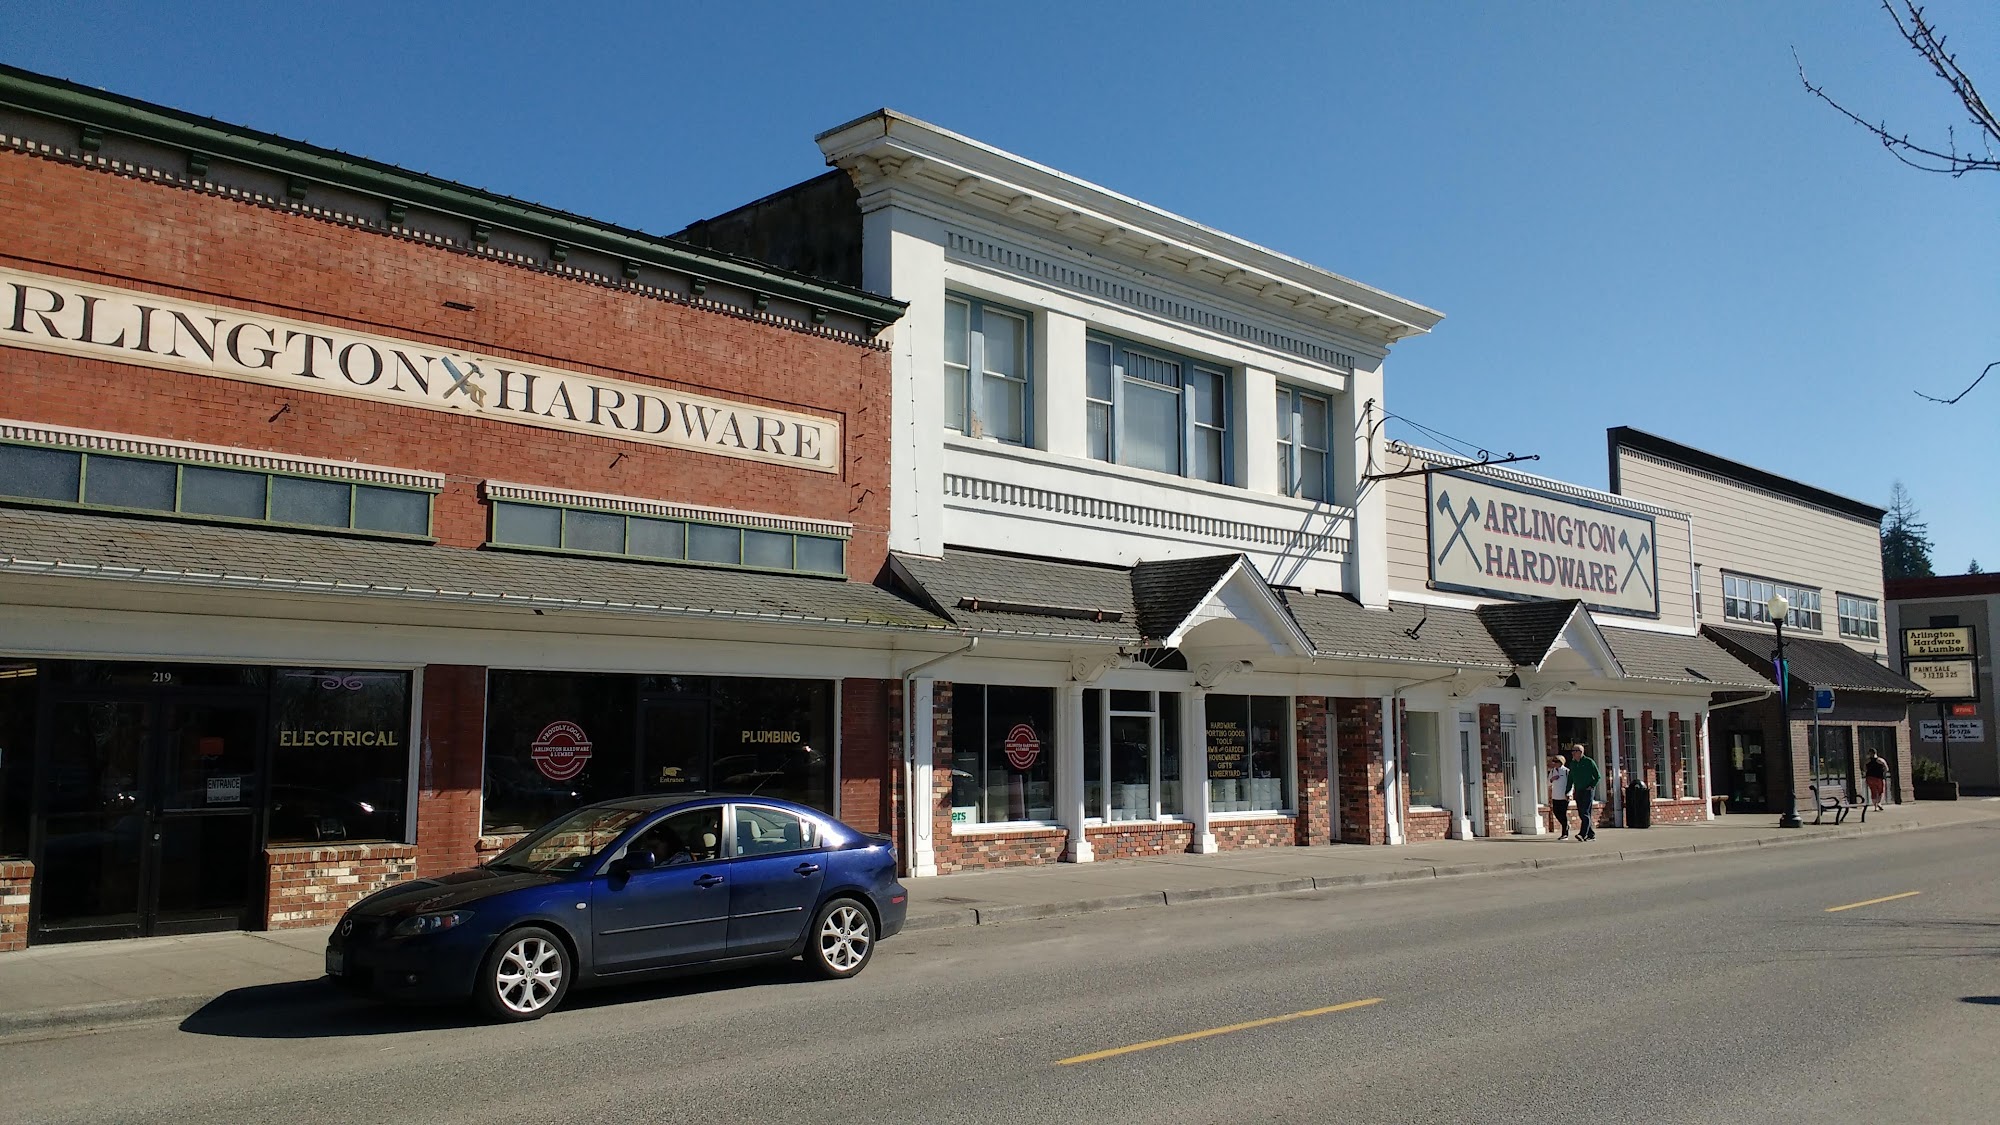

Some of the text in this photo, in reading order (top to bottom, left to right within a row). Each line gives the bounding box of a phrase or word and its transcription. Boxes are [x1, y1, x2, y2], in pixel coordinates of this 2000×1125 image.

[3, 282, 822, 461] RLINGTON HARDWARE
[1484, 499, 1616, 555] ARLINGTON
[1485, 543, 1618, 594] HARDWARE
[1913, 637, 1961, 646] Hardware
[1927, 645, 1965, 653] Lumber
[152, 671, 172, 682] 219
[280, 730, 399, 747] ELECTRICAL
[542, 724, 583, 741] PROUDLY LOCAL
[741, 730, 801, 743] PLUMBING
[208, 778, 240, 789] ENTRANCE
[952, 811, 966, 821] ers
